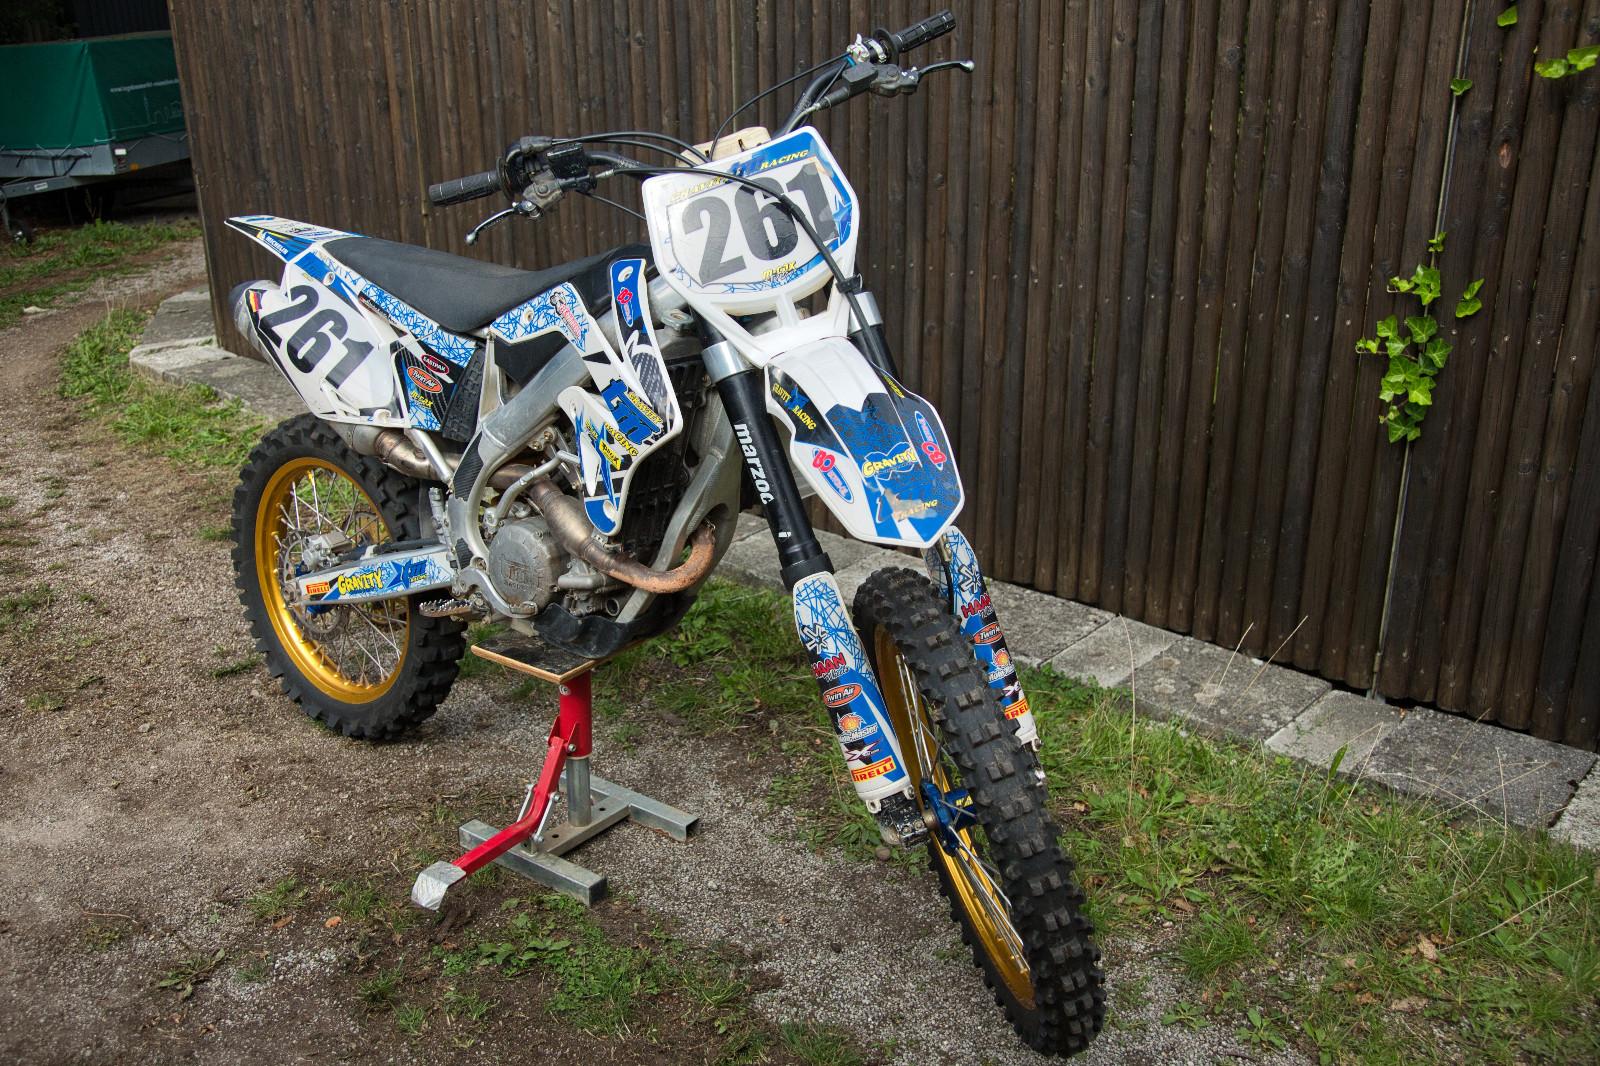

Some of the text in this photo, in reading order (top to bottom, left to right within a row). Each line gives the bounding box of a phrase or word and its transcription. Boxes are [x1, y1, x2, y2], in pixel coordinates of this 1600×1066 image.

[760, 149, 809, 170] RACING
[681, 163, 839, 286] 261
[265, 235, 289, 255] MICHELIN
[259, 285, 374, 389] 261
[422, 355, 446, 372] EASTPAK
[792, 404, 817, 430] RACING
[862, 447, 918, 478] GRAVITY
[306, 581, 331, 595] PIRELLI
[337, 566, 384, 595] GRAVITY
[980, 627, 996, 640] Twin
[826, 686, 856, 702] Twin Air
